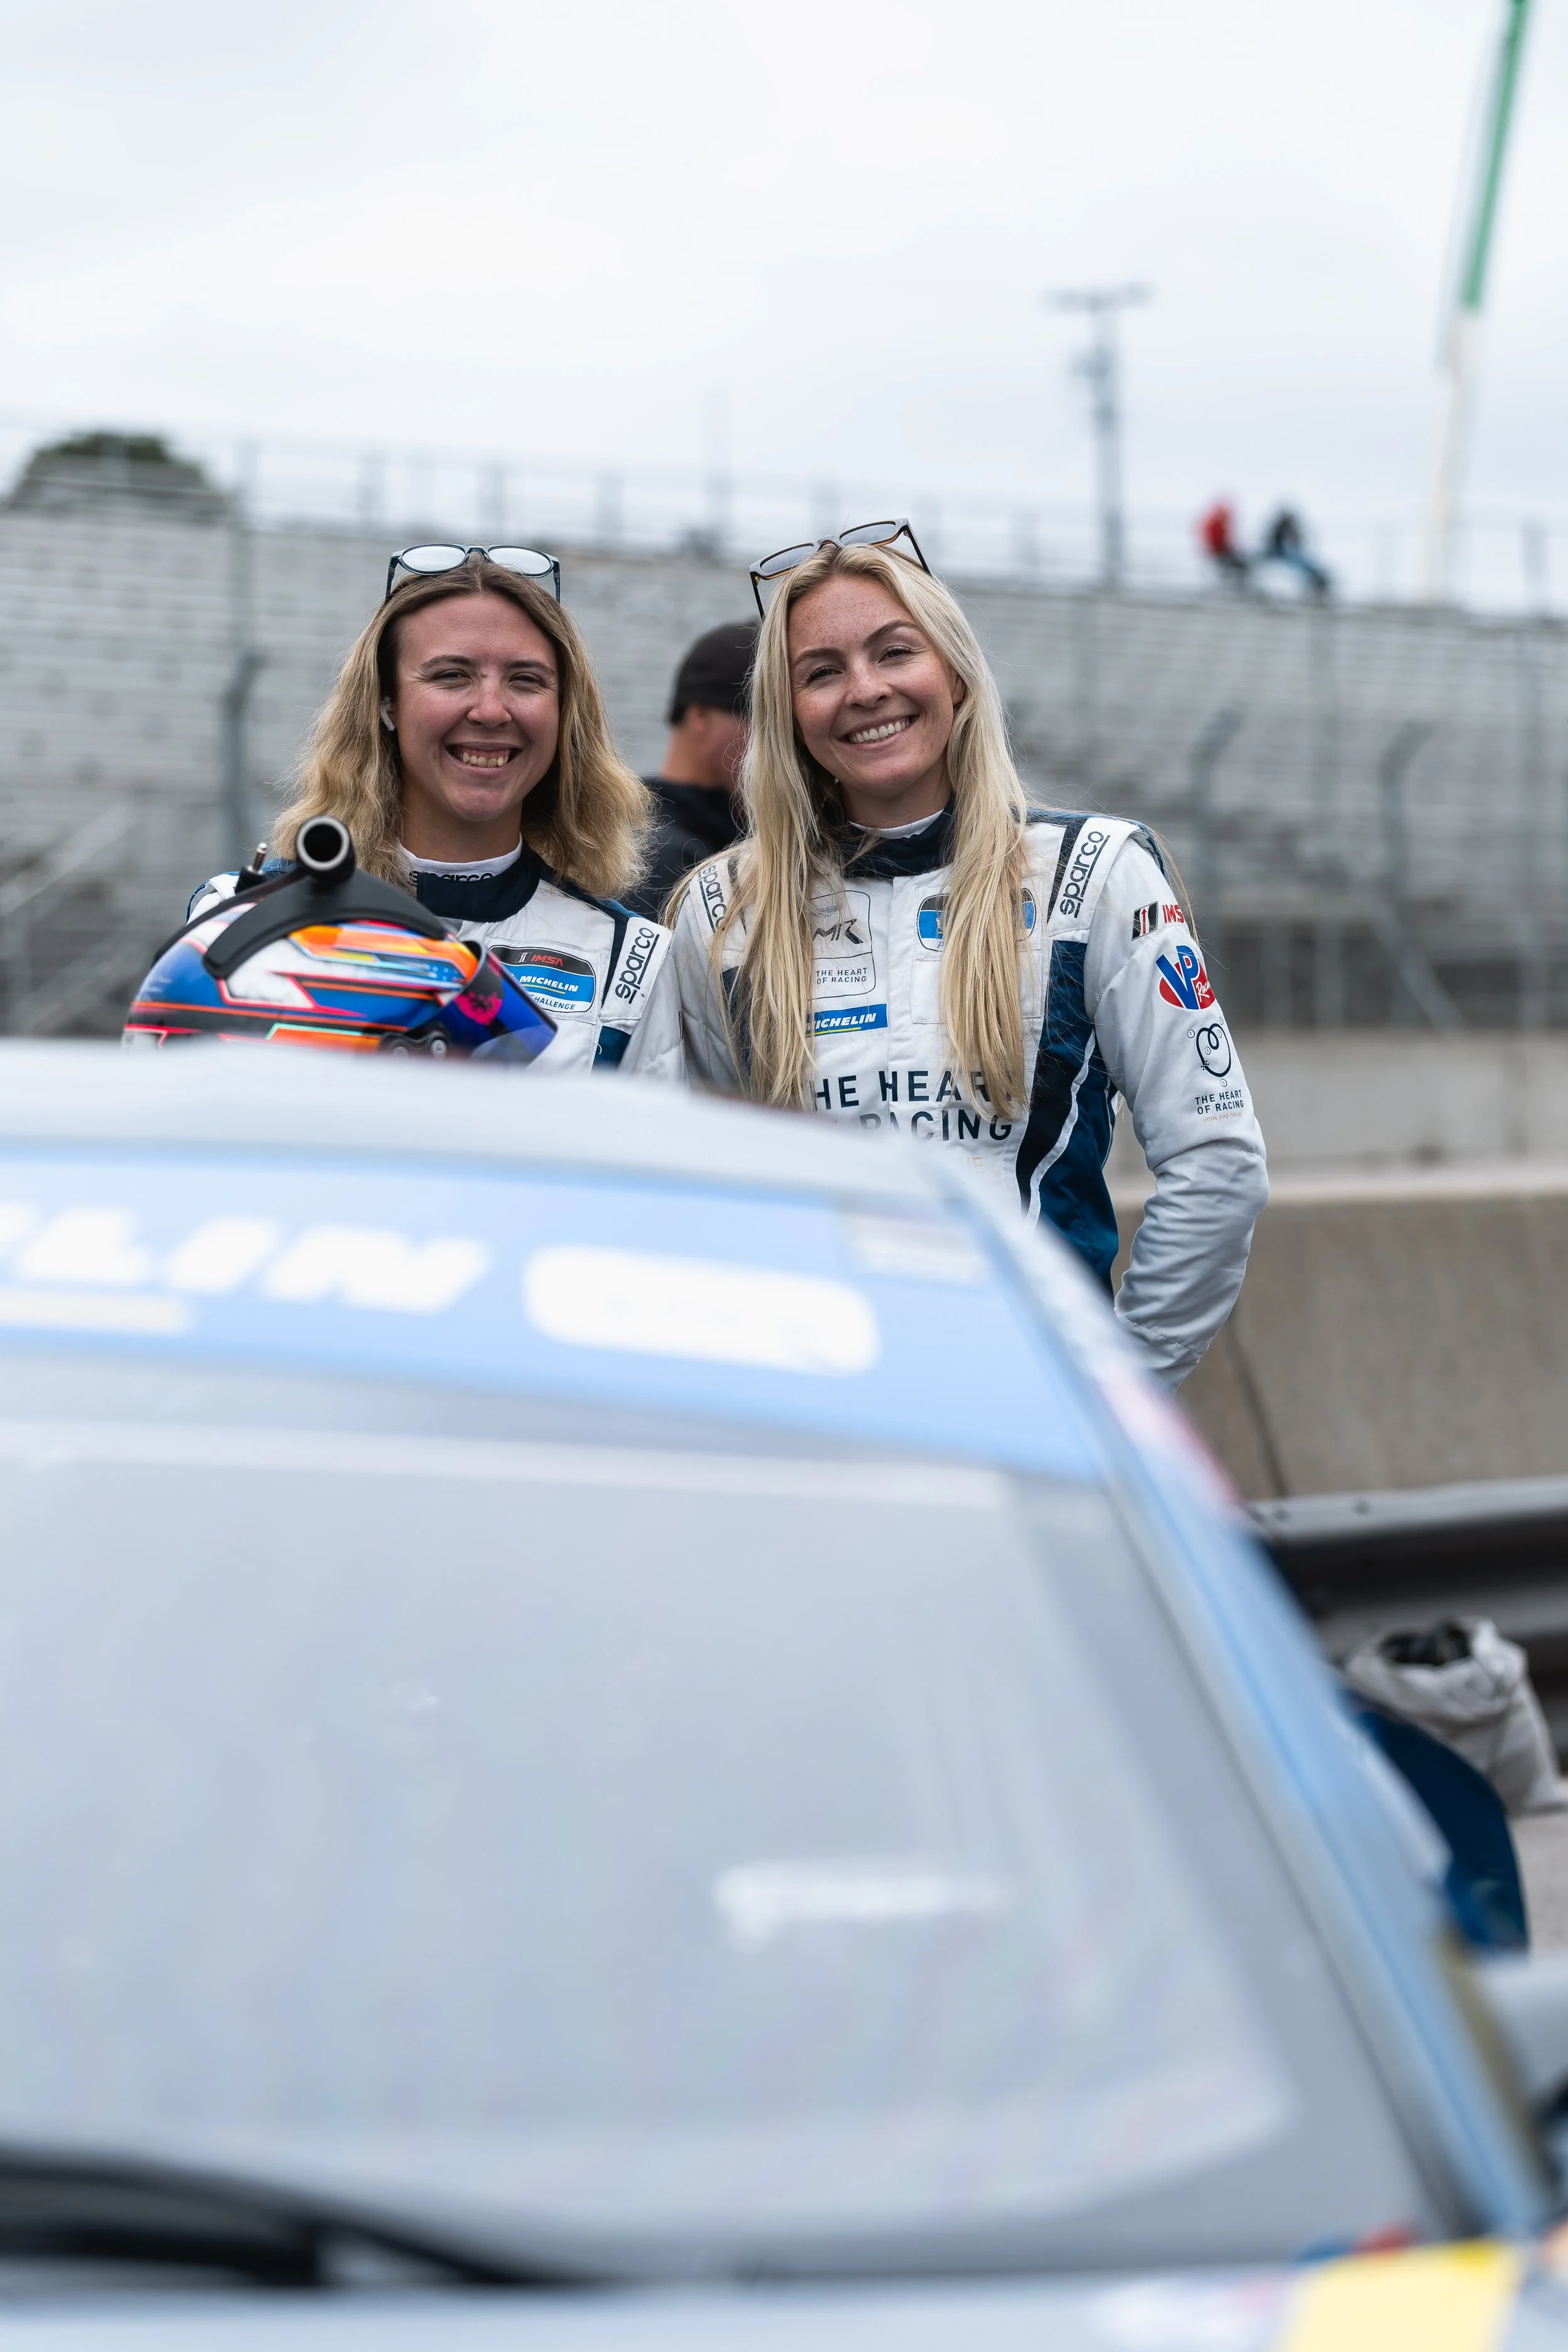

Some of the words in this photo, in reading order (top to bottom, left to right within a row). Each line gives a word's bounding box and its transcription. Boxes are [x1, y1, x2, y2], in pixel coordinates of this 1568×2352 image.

[1060, 831, 1104, 914] sparco
[1162, 904, 1184, 923] IMS
[531, 954, 563, 967] IMSA
[615, 927, 654, 999] sparco
[837, 967, 867, 976] HEART
[1156, 945, 1199, 1010] VP
[519, 975, 579, 992] MICHELIN
[809, 1074, 859, 1111] HE
[878, 1071, 1012, 1102] HEAR
[1195, 1094, 1216, 1105] THE
[1219, 1090, 1242, 1100] HEART
[1197, 1105, 1210, 1115] OF
[1215, 1100, 1244, 1111] RACING
